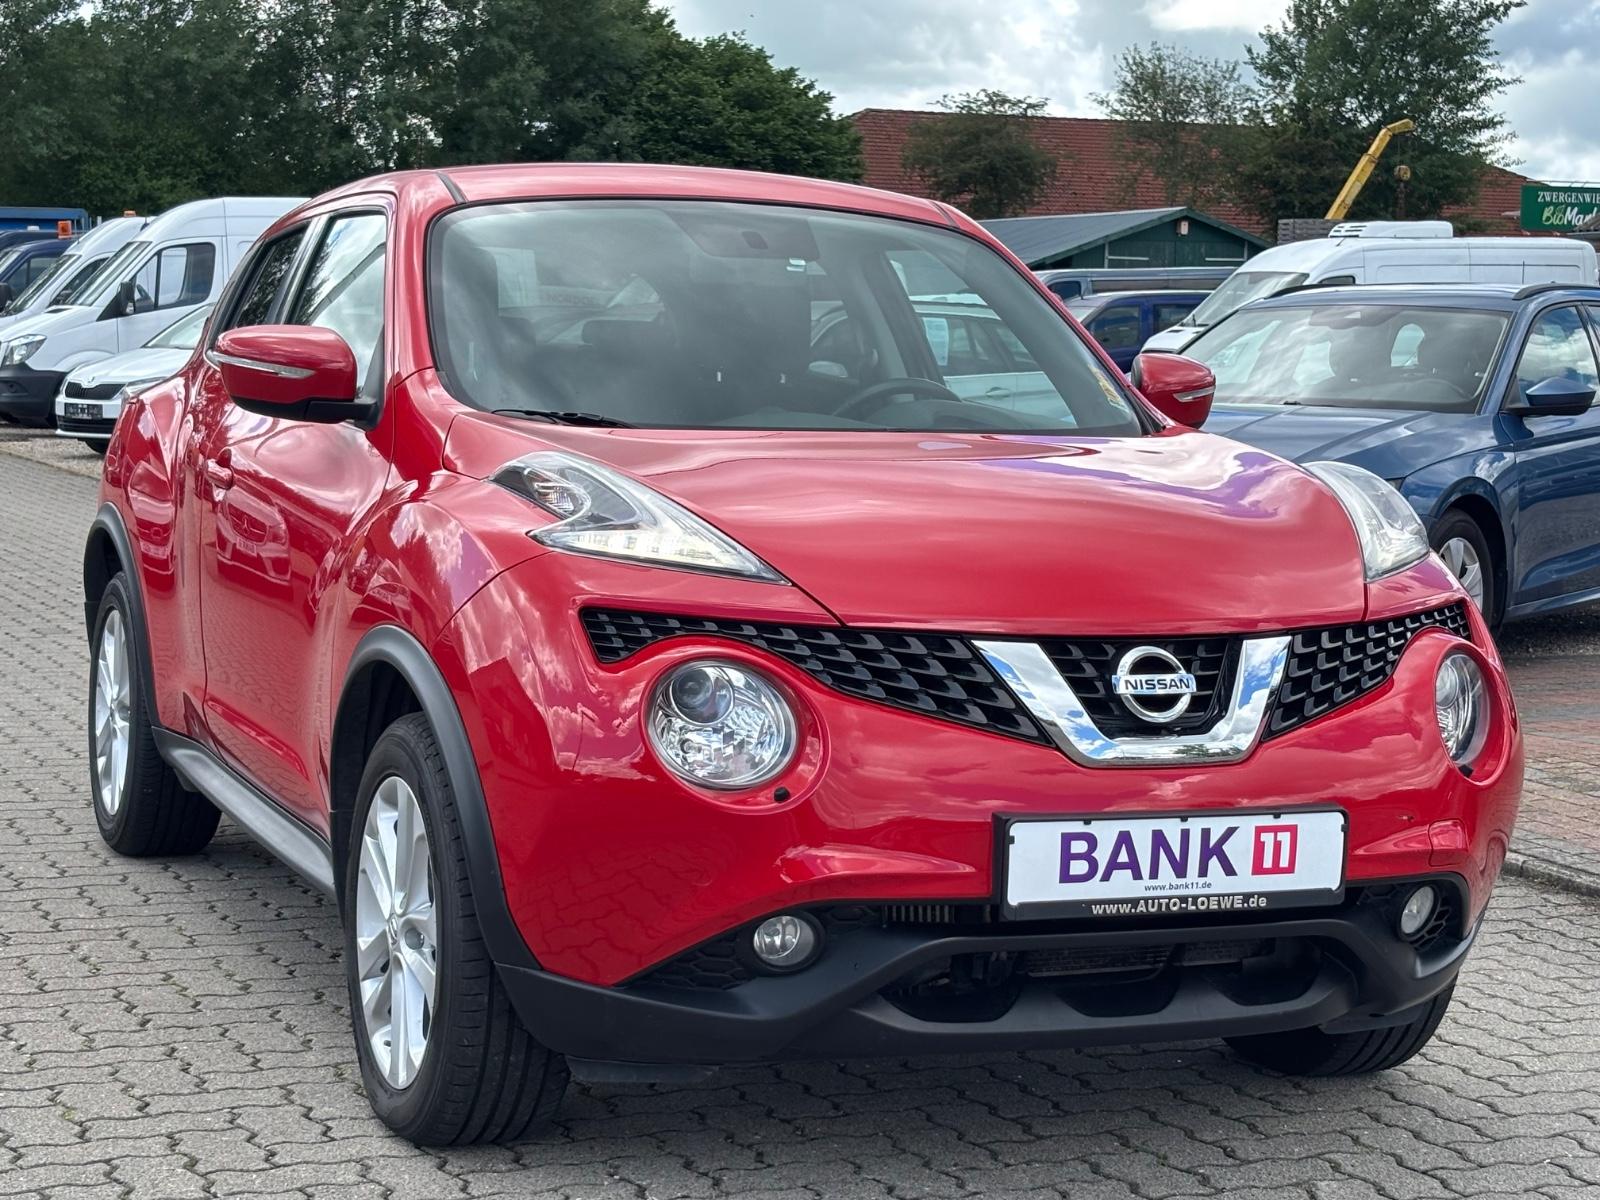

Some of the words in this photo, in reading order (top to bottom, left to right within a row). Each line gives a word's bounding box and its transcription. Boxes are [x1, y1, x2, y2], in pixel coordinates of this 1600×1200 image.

[1124, 678, 1190, 690] NISSAN
[1059, 826, 1240, 884] BANK
[1260, 831, 1291, 869] 11
[1144, 881, 1212, 892] www.bank11.de
[1091, 895, 1267, 915] www.AUTO-LOEWE.de
